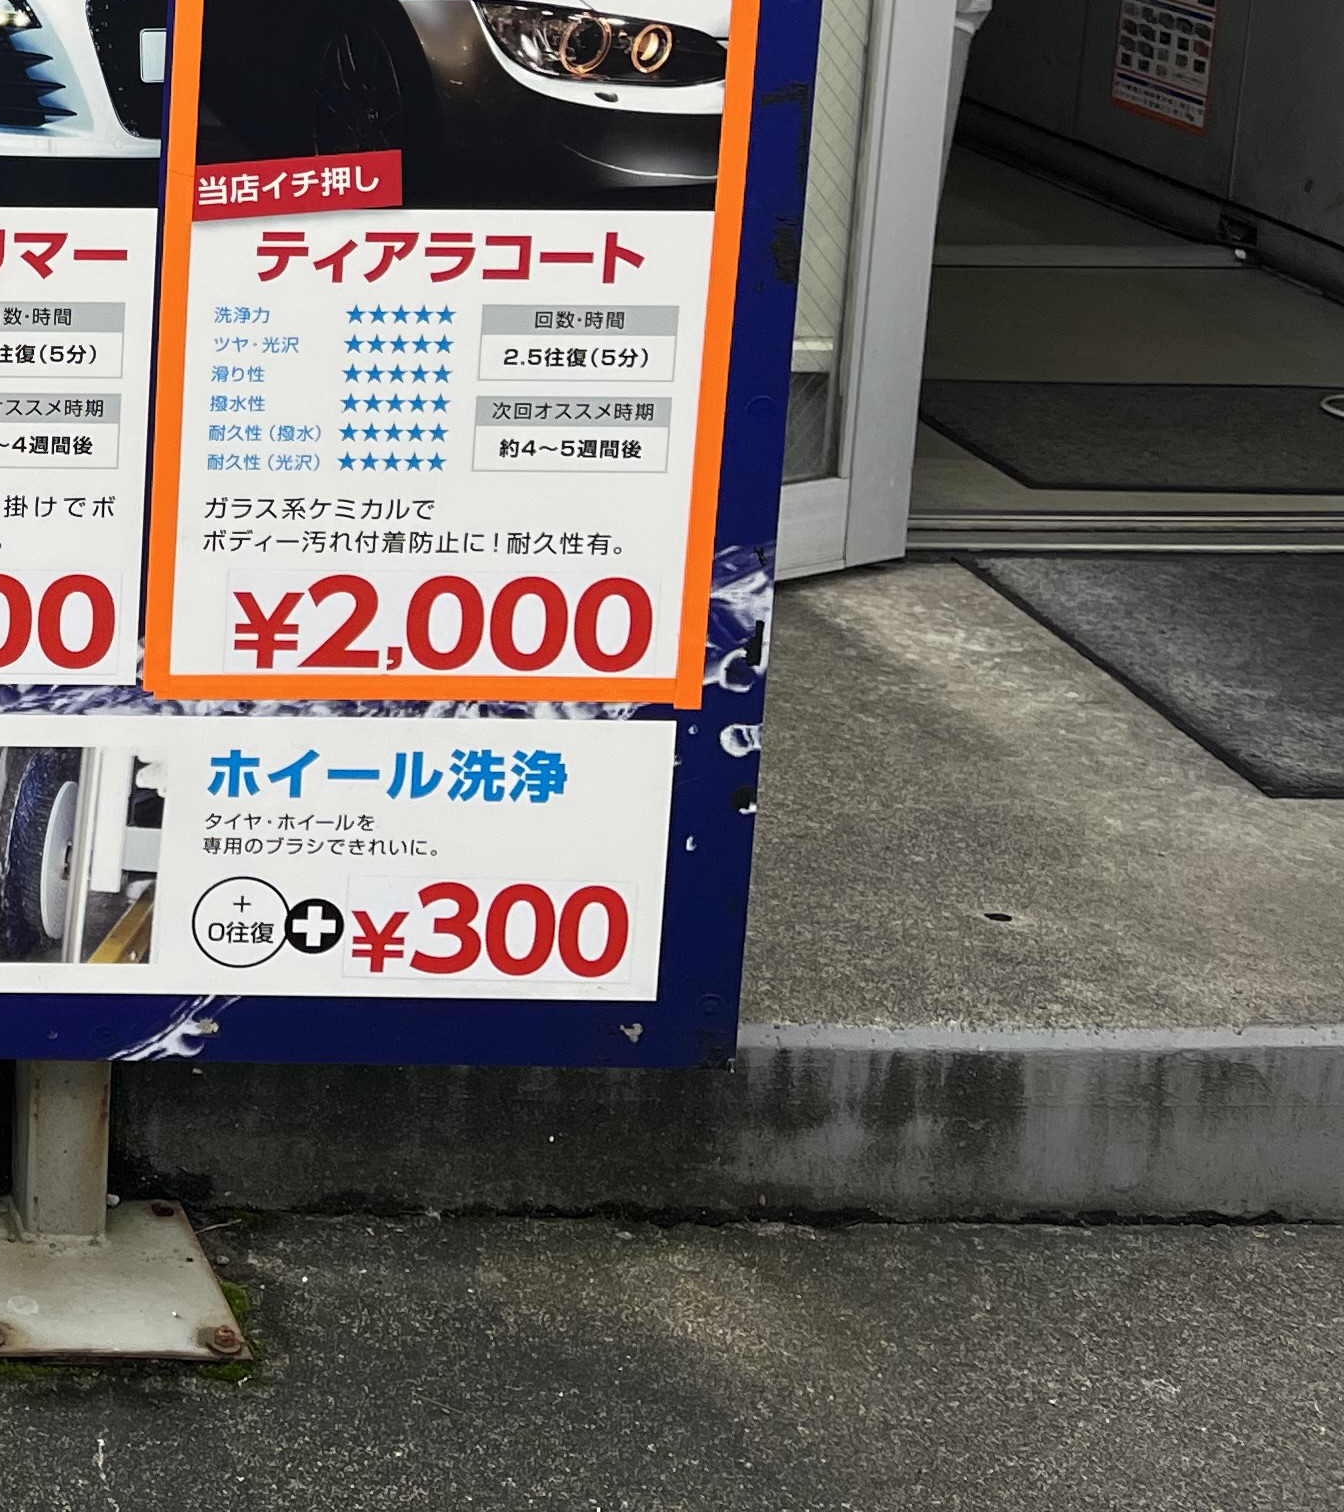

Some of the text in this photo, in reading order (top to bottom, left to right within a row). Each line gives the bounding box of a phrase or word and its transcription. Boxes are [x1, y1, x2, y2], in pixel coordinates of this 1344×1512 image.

[197, 166, 380, 206] 当店イチ押し
[257, 232, 644, 283] ティアラコート
[215, 307, 269, 323] 洗浄力
[535, 311, 624, 329] 回数・時間
[504, 348, 648, 368] 2.5往復(5分)
[211, 366, 265, 382] 滑り性
[210, 395, 265, 412] 撥水性
[492, 402, 654, 421] 次回オススメ時期
[499, 439, 642, 459] 約4～5週間後
[205, 497, 434, 520] ガラス系ケミカルで
[233, 575, 652, 672] ¥2,000
[208, 749, 567, 803] ホイール洗浄
[205, 813, 374, 831] タイヤ・ホイールを
[203, 837, 437, 856] 専用のブラシできれいに。
[352, 882, 628, 978] ¥300
